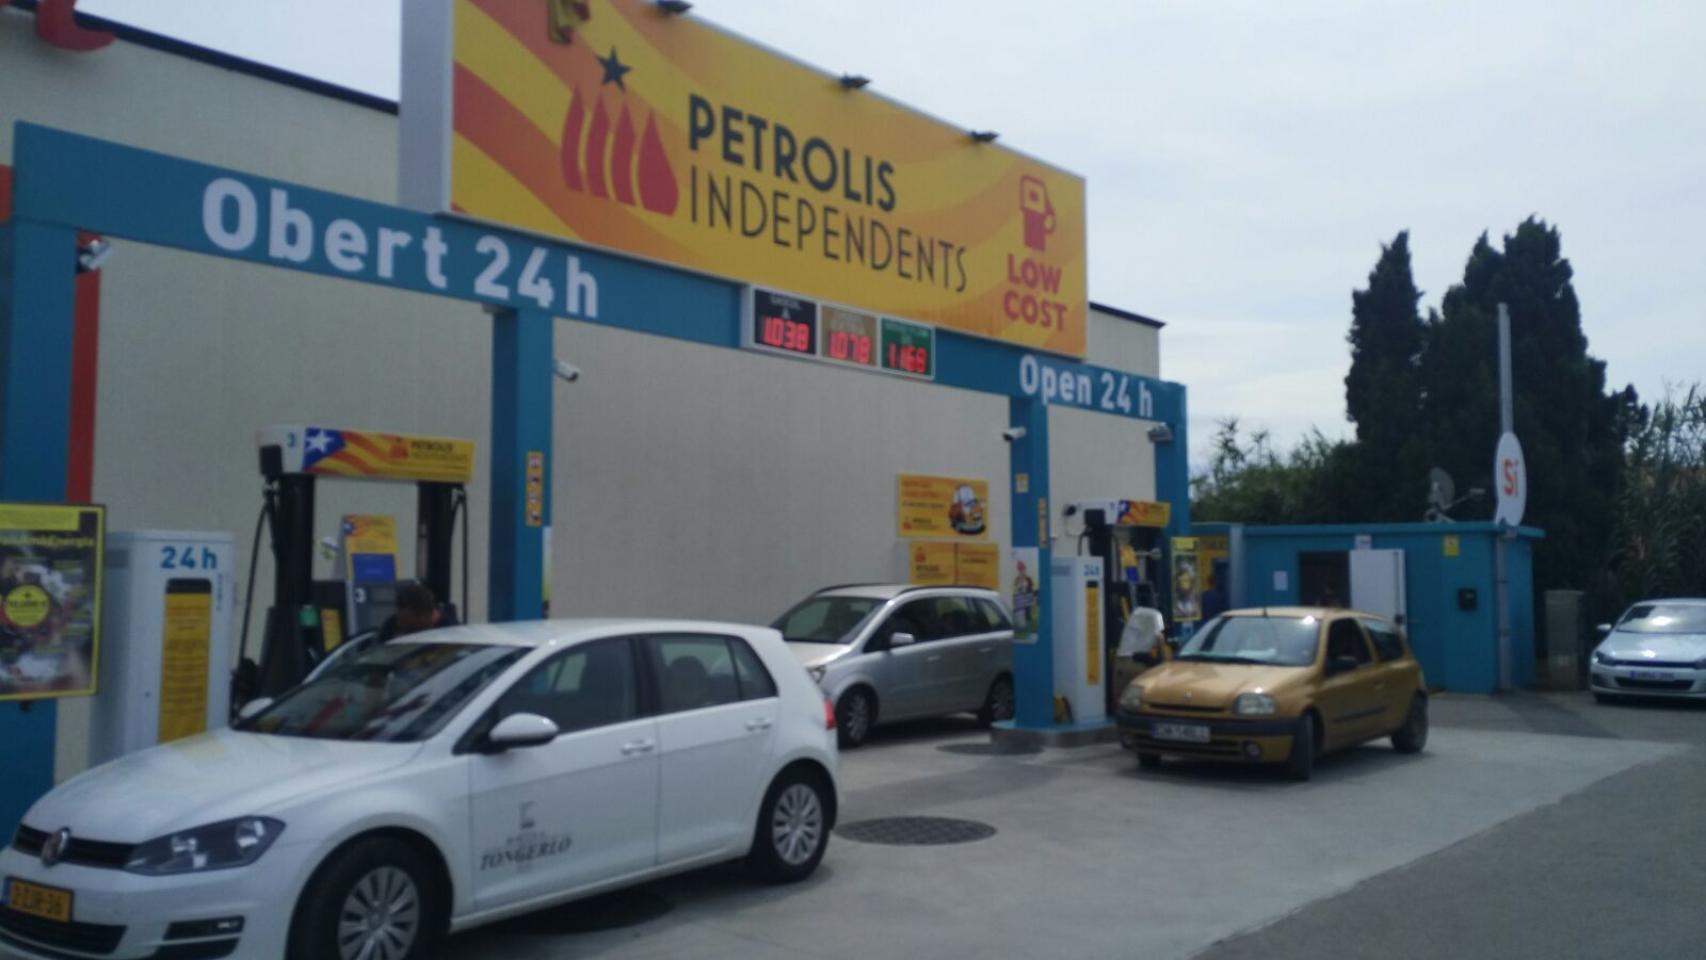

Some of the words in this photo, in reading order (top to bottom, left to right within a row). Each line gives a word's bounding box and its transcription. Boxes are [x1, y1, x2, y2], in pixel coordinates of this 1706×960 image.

[689, 94, 896, 212] PETROLIS
[202, 178, 448, 289] Obert
[691, 164, 967, 292] INDEPENDENTS
[1007, 253, 1062, 294] LOW
[1003, 290, 1068, 332] COST
[1019, 354, 1093, 406] Open
[354, 587, 367, 604] 3
[480, 836, 573, 872] TONGERLO
